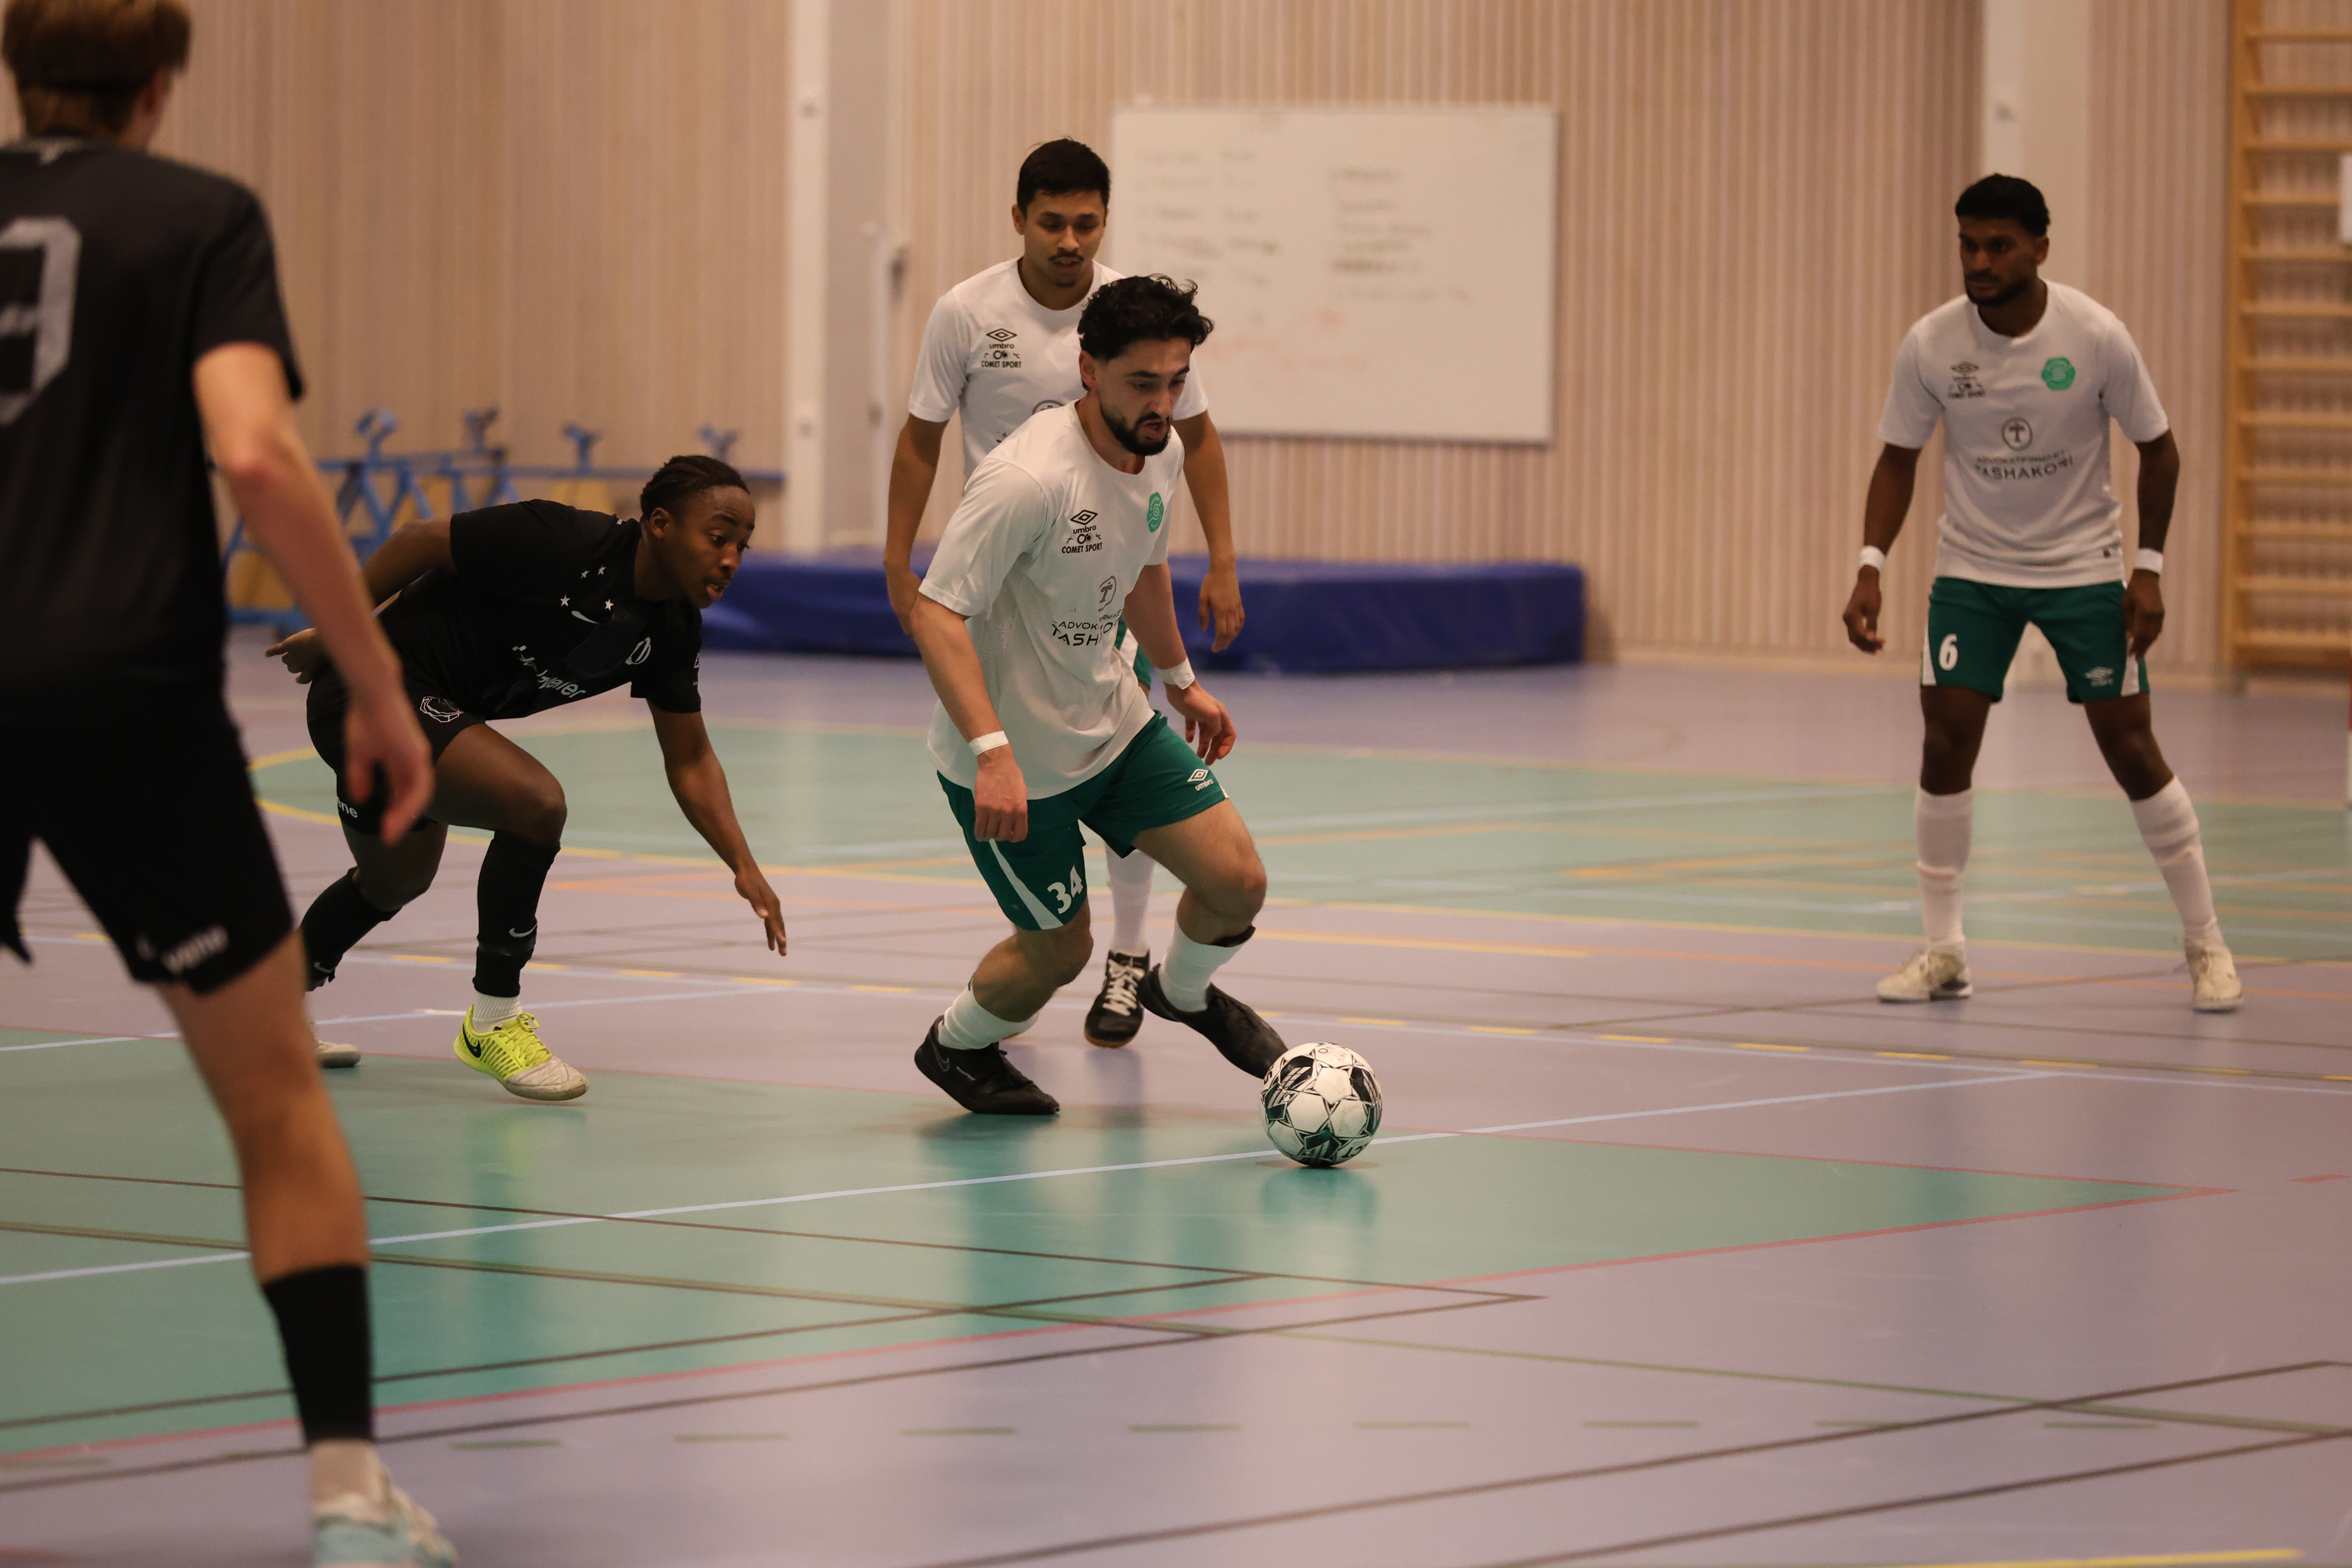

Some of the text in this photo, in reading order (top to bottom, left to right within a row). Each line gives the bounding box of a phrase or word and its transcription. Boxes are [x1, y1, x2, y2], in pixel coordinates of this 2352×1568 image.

[1073, 525, 1096, 534] umbro
[1062, 542, 1103, 554] COMET SPORT
[1938, 633, 1958, 671] 6
[1195, 779, 1214, 791] umbro
[1047, 864, 1084, 915] 34
